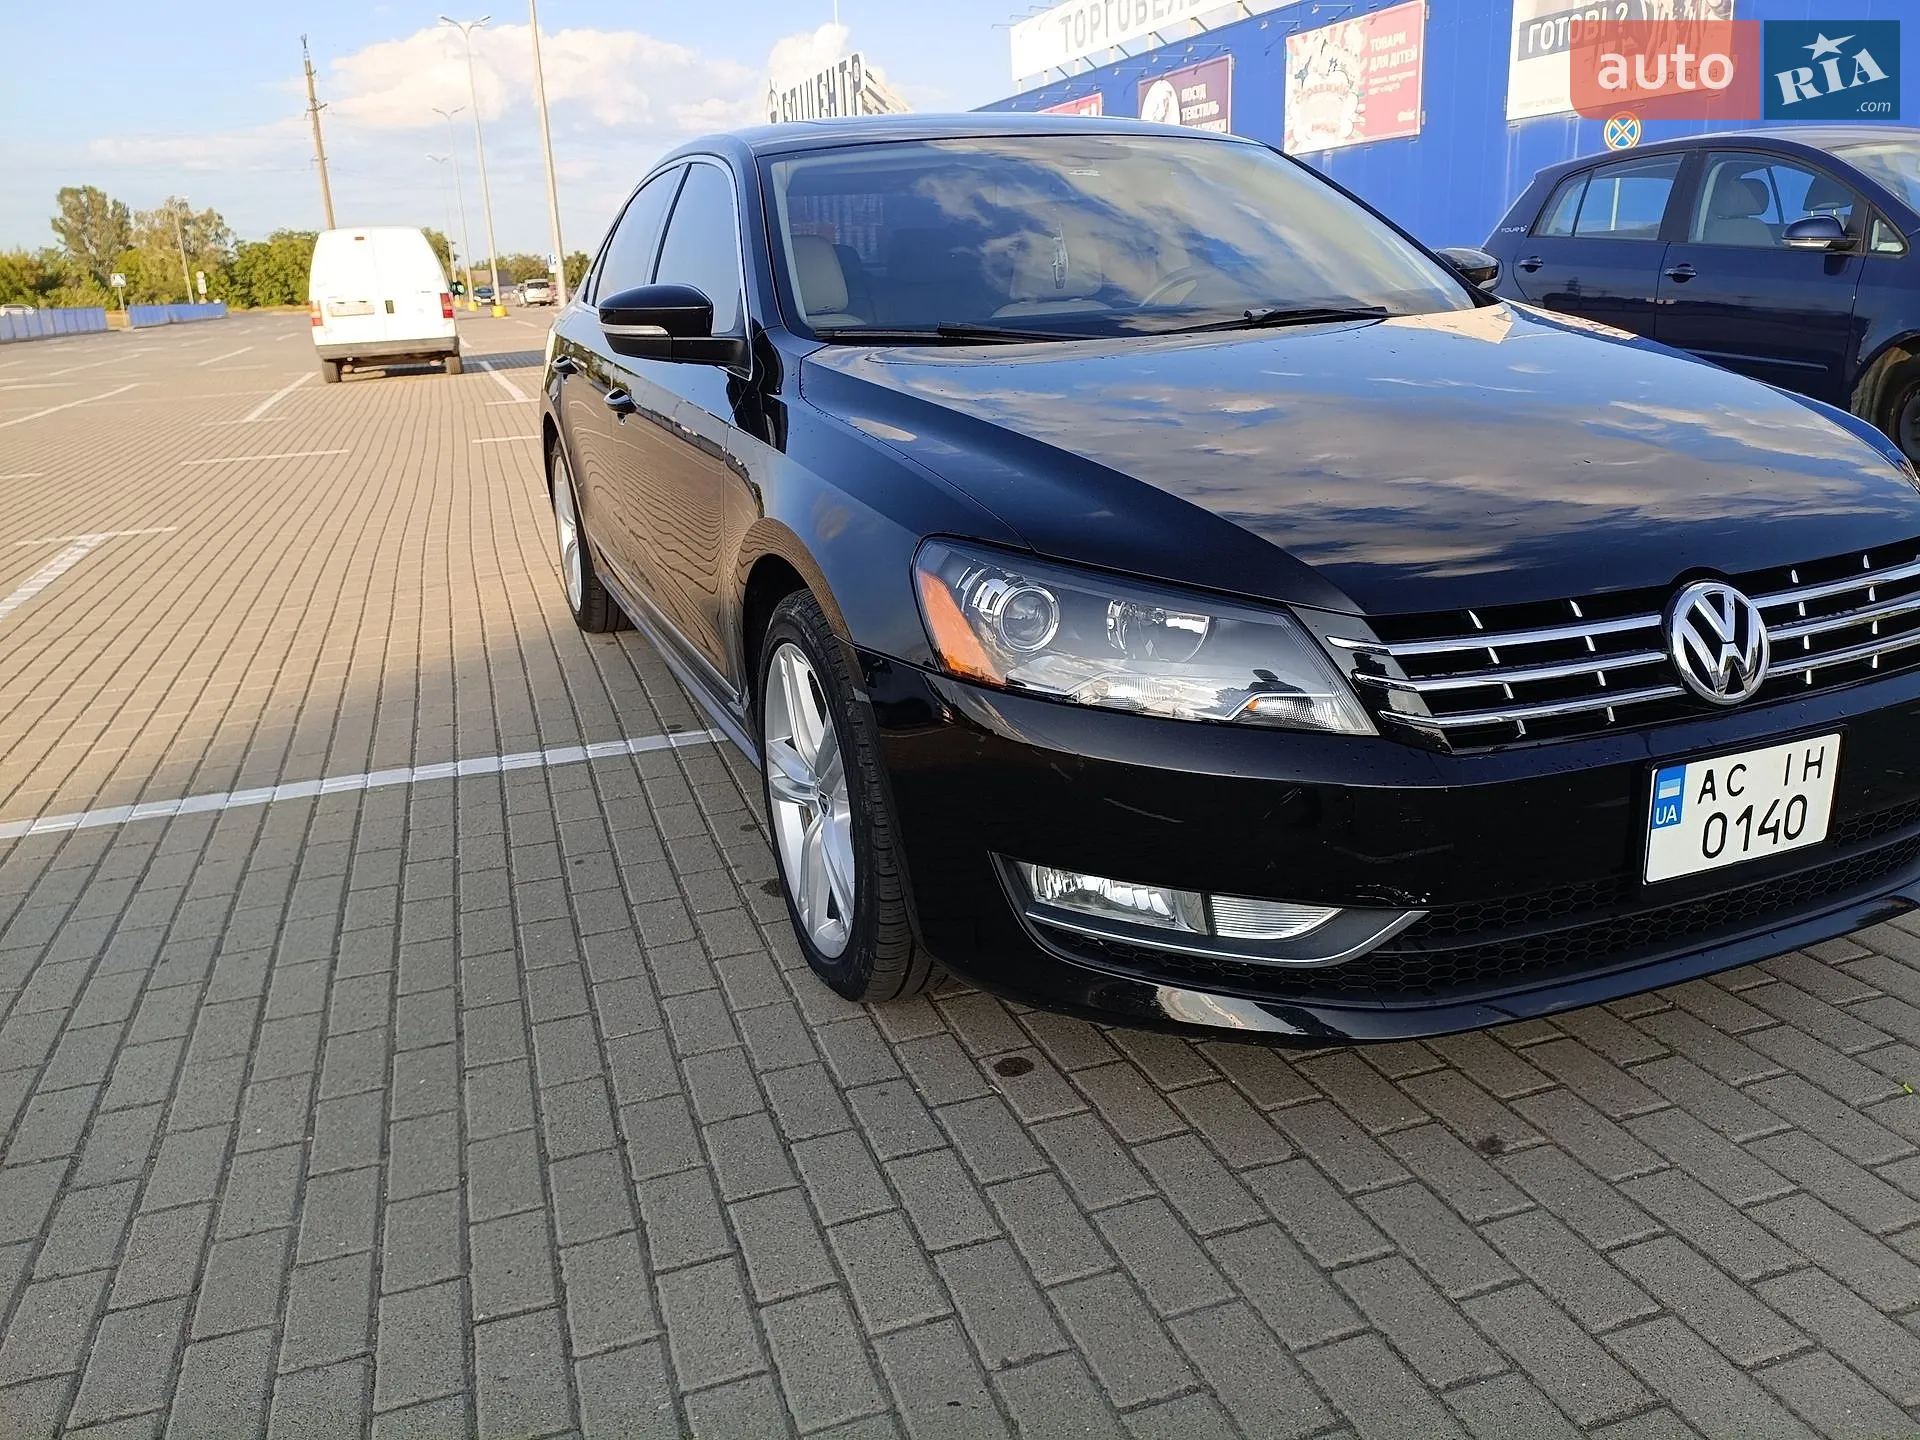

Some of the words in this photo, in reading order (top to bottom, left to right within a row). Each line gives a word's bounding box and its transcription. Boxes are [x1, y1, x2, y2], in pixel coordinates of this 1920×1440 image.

[1528, 7, 1607, 53] ГОТОВІ
[1697, 763, 1747, 804] AC
[1783, 746, 1825, 786] IH
[1656, 804, 1677, 825] UA
[1702, 794, 1808, 858] 0140
